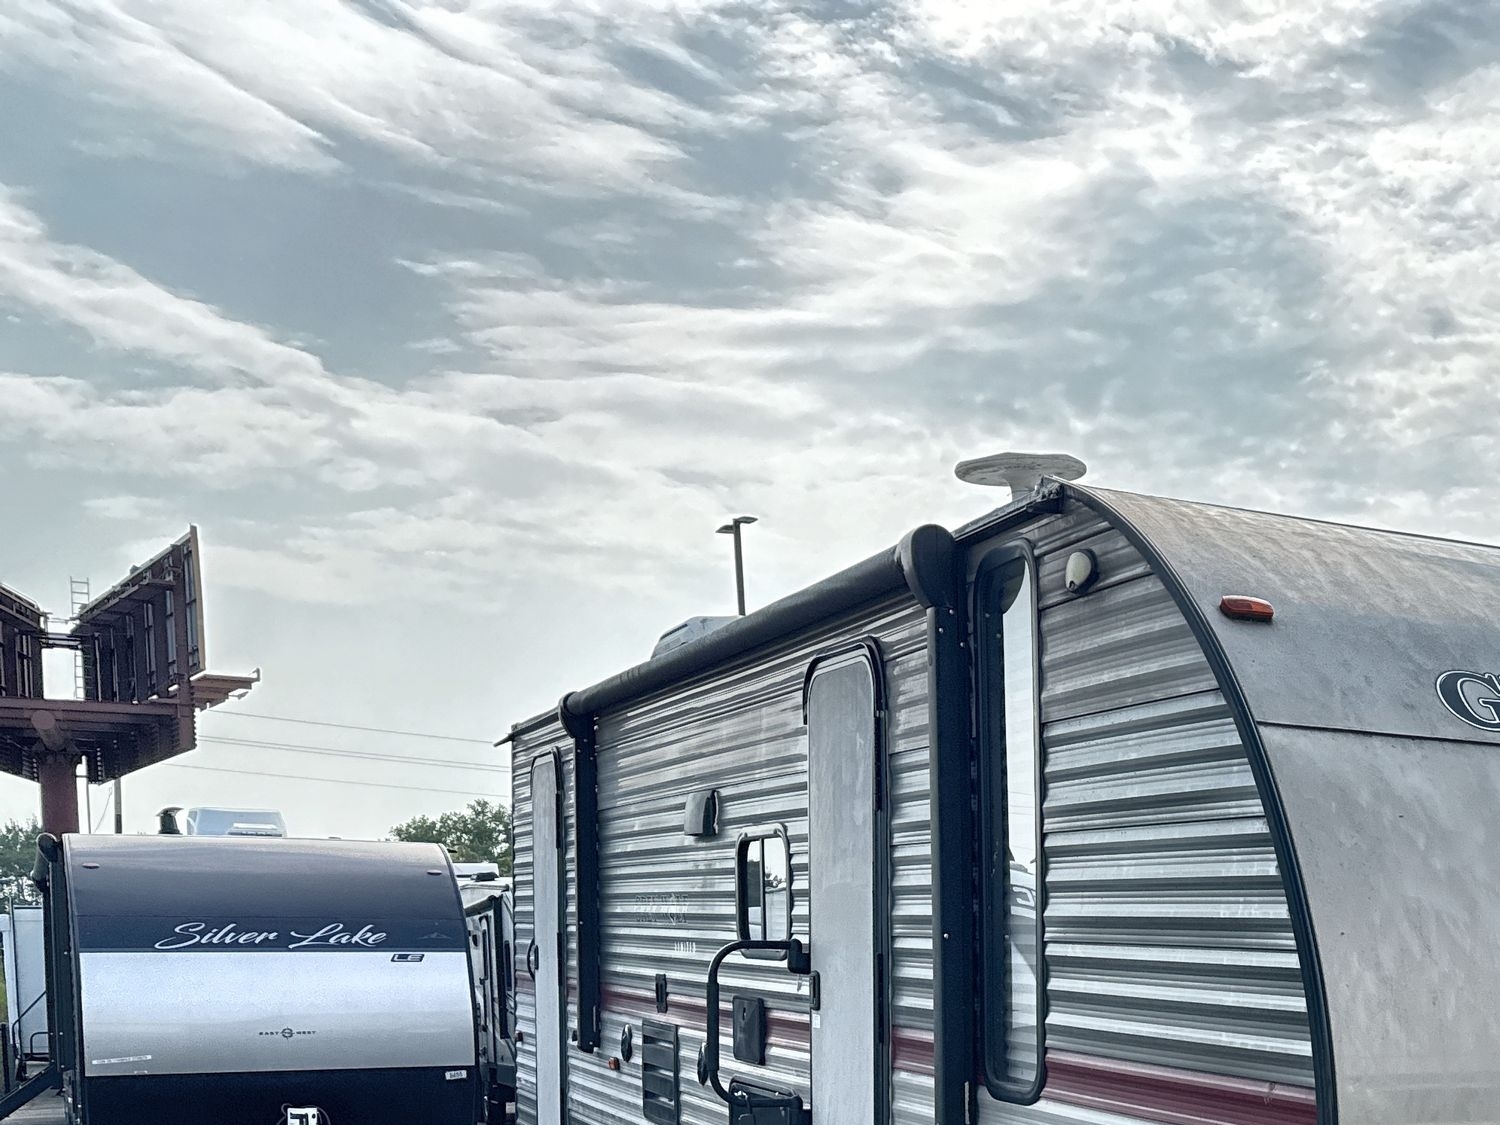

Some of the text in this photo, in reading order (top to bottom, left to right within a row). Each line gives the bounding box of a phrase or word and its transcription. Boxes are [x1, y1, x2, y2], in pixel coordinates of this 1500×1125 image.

[154, 922, 388, 950] Silver Lake
[393, 954, 423, 962] LE
